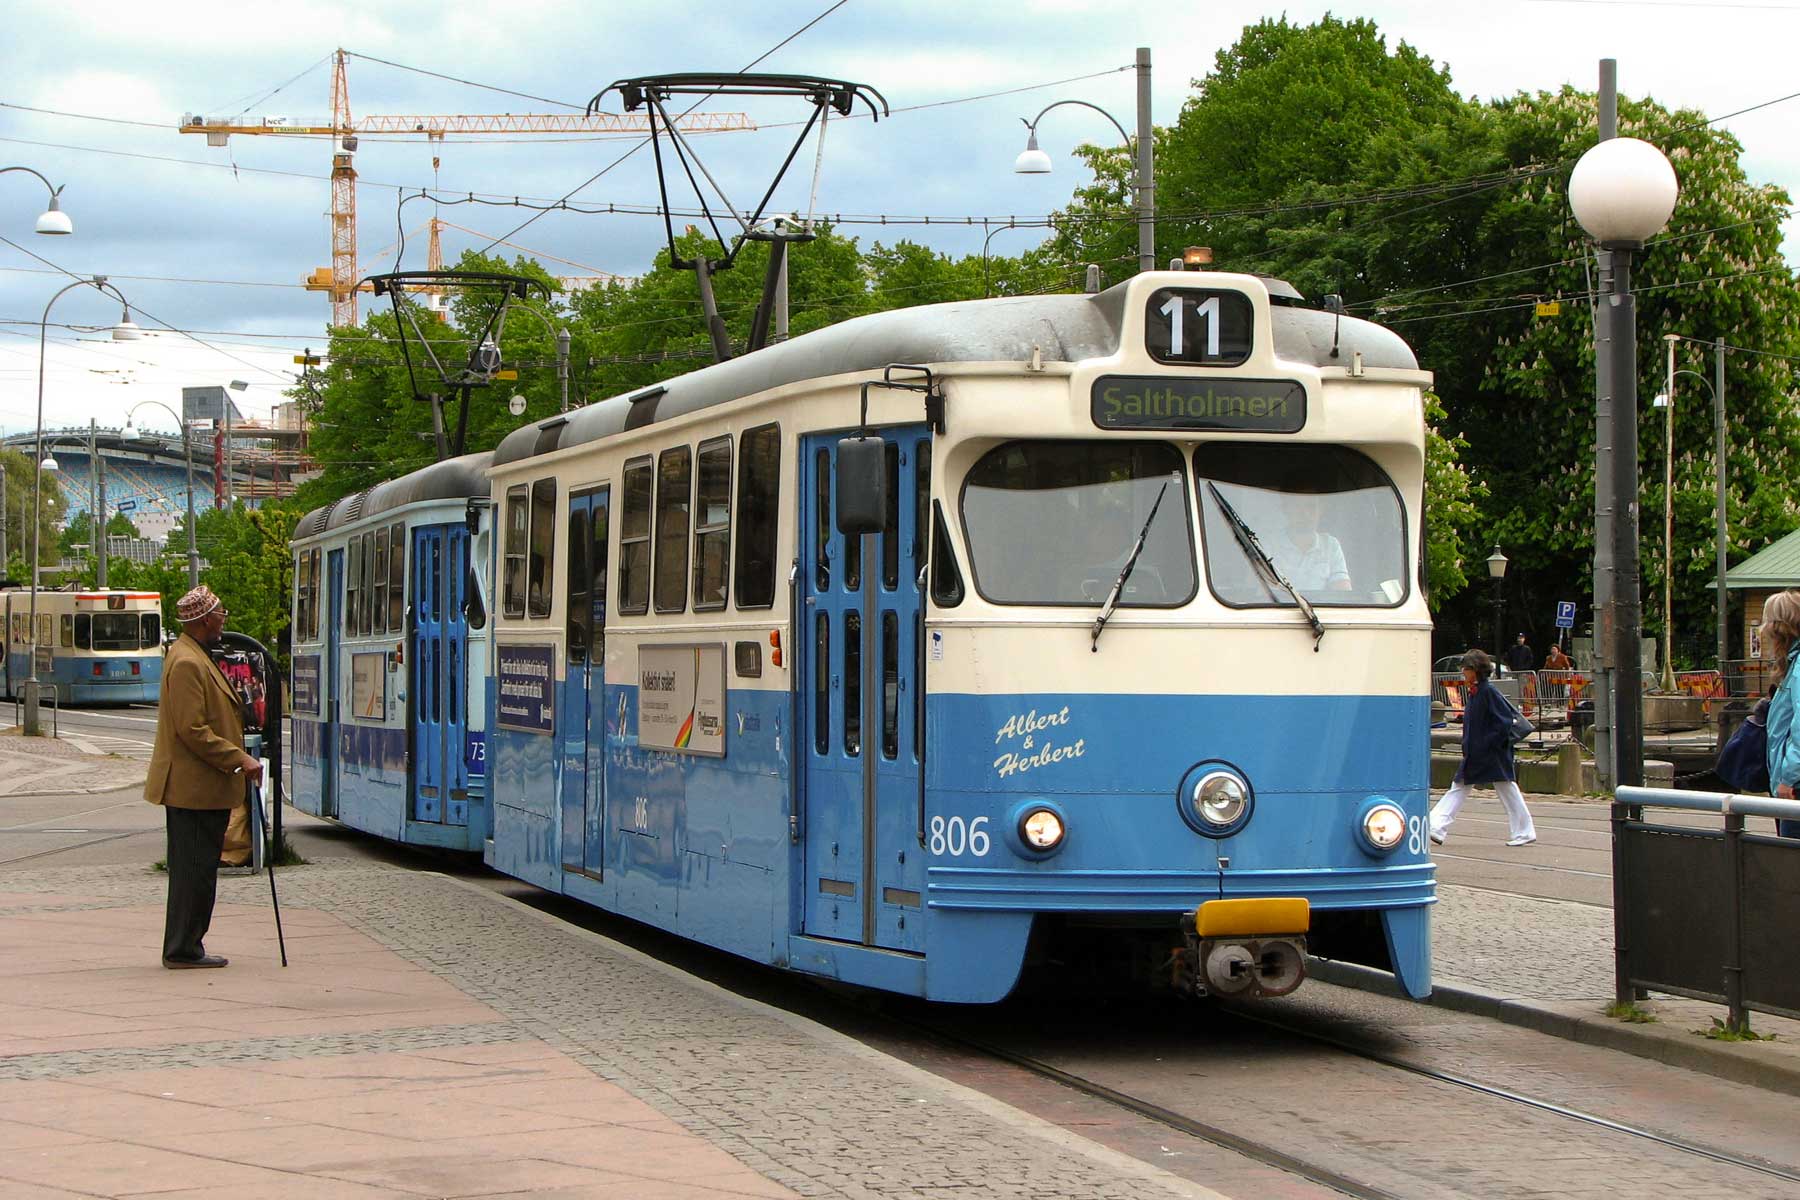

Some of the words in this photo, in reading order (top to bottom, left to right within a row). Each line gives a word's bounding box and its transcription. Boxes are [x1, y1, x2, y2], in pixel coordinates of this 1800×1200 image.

[1159, 296, 1221, 356] 11
[1103, 386, 1288, 417] Saltholmen
[112, 596, 120, 609] 7
[1562, 604, 1572, 616] P
[995, 706, 1070, 744] Albert
[993, 739, 1085, 778] Herbert
[1023, 735, 1034, 750] &
[635, 796, 648, 829] 806
[930, 815, 990, 857] 806
